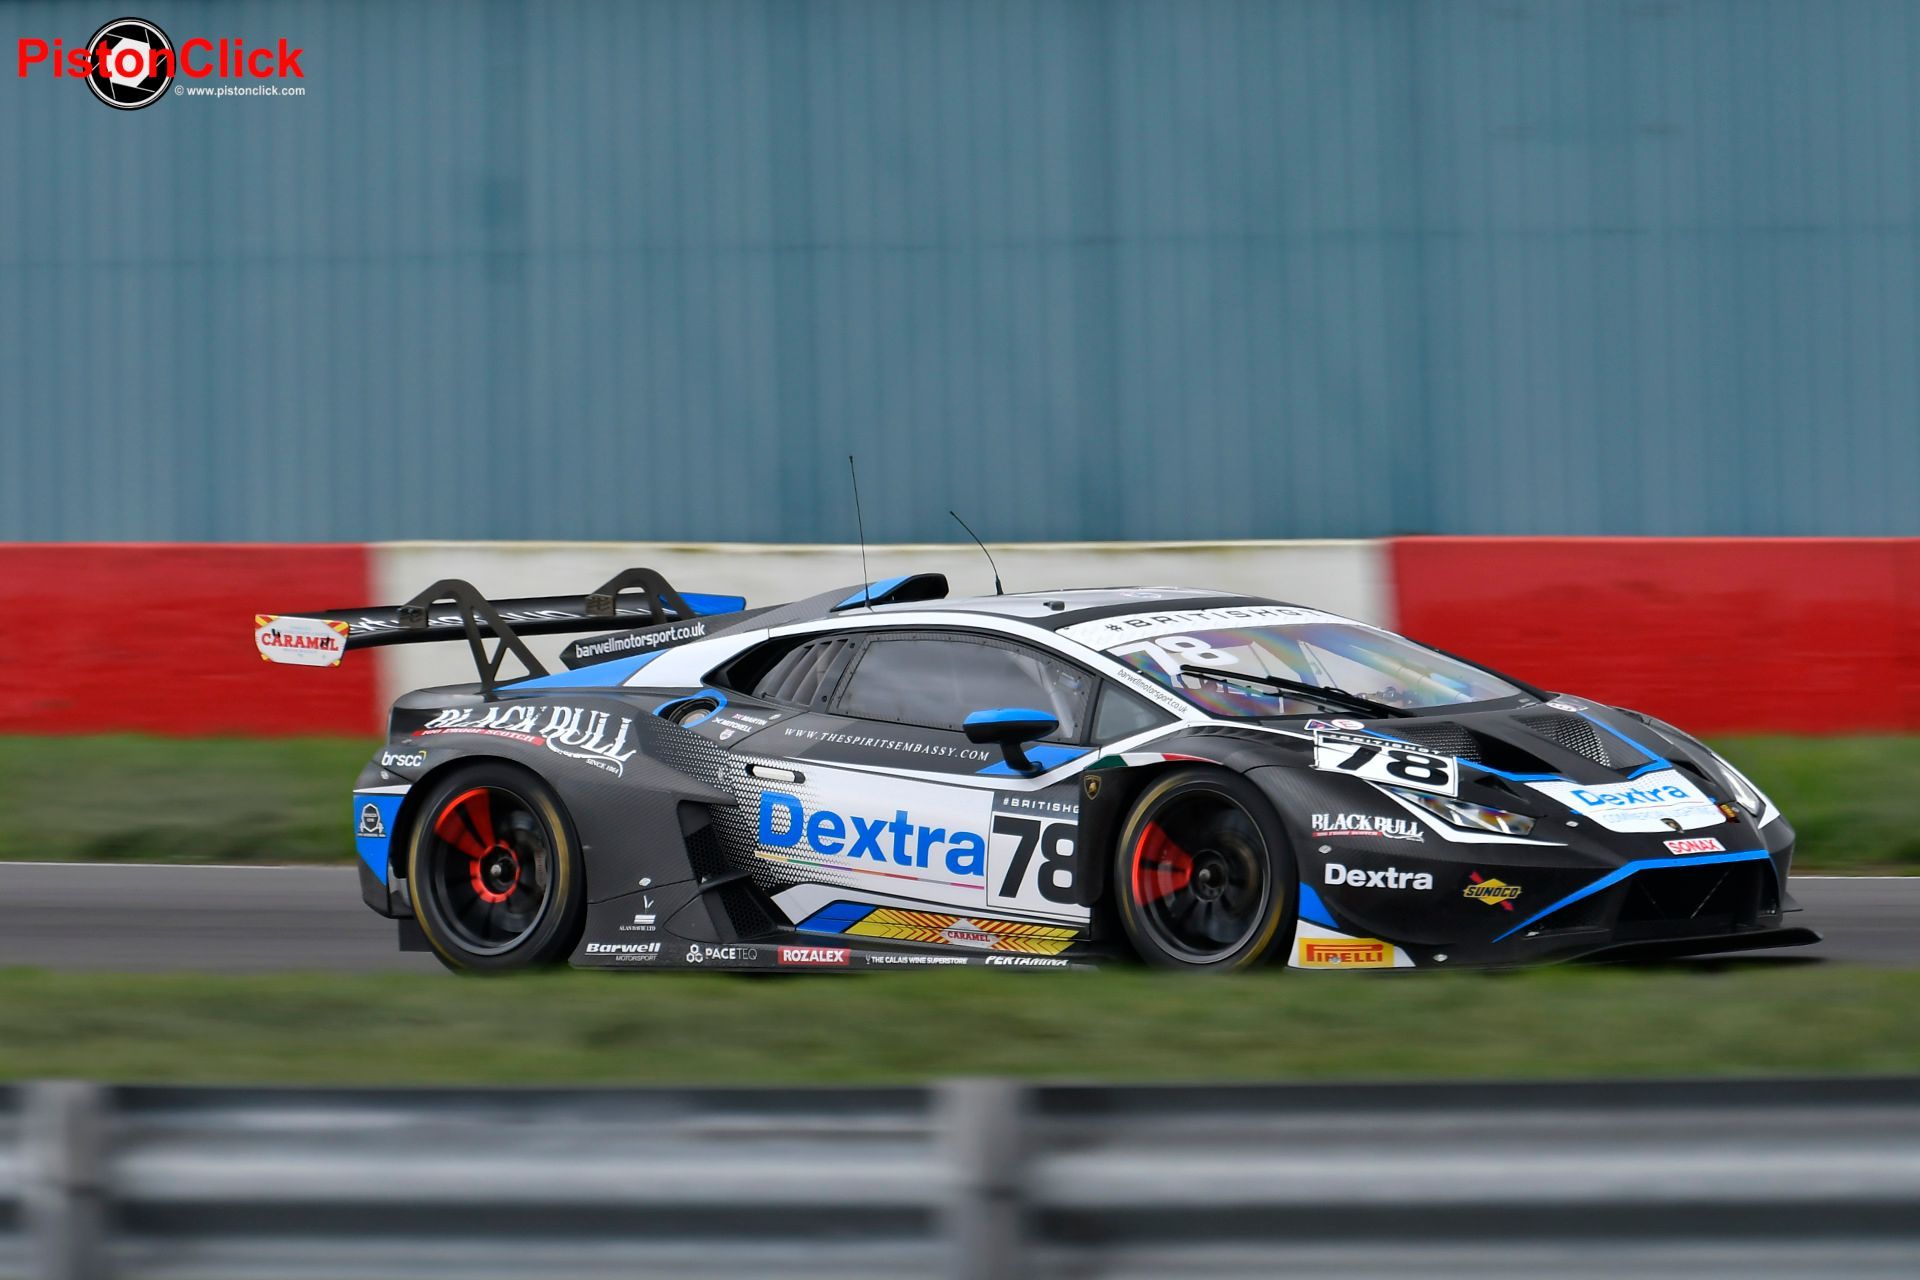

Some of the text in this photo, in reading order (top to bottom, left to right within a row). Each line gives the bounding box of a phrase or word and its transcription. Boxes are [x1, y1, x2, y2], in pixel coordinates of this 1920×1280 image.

[261, 633, 339, 651] CARAMEL
[575, 622, 706, 658] barwellmotorsport.co.uk
[1106, 635, 1239, 676] 78
[1117, 668, 1188, 714] barwellmotorsport.co.uk
[784, 728, 990, 762] WWW.THESPIRITSEMBASSY.COM
[381, 752, 423, 767] brscc
[1322, 737, 1449, 786] 78
[1569, 785, 1690, 807] Dextra
[759, 791, 985, 877] Dextra
[1311, 813, 1424, 836] BLACK BULL
[1668, 839, 1718, 853] SONAX
[993, 815, 1081, 904] 78
[1324, 863, 1433, 890] Dextra
[1466, 886, 1519, 897] SUNOCO
[586, 942, 661, 953] Barwell
[947, 931, 990, 942] CARAMEL
[705, 948, 758, 960] PACETEQ
[783, 950, 844, 962] ROZALEX
[1306, 944, 1384, 962] PIRELLI
